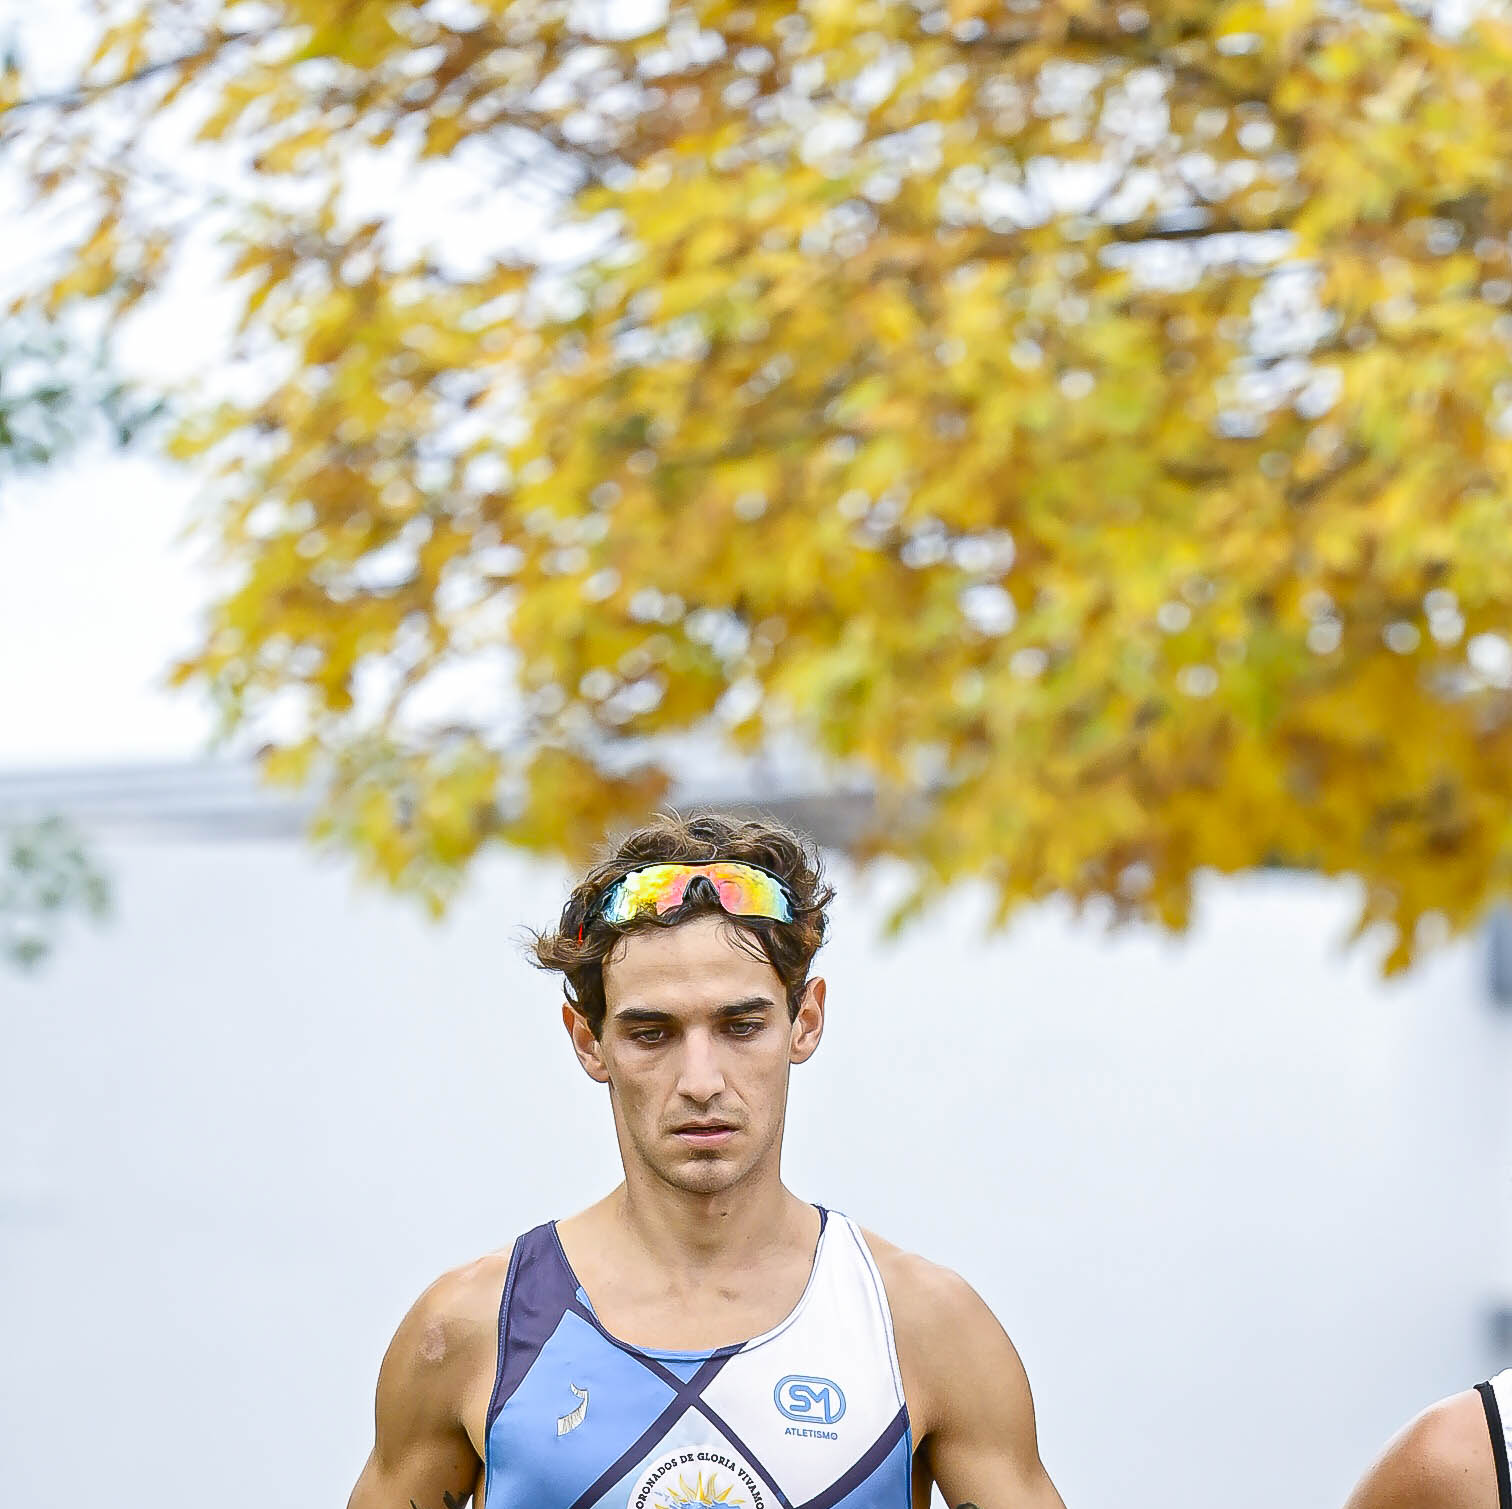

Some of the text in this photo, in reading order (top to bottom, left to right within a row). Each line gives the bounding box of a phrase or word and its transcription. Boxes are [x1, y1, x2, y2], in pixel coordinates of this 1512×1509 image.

[785, 1427, 838, 1441] ATLETISMO
[680, 1453, 695, 1464] DE
[697, 1453, 736, 1472] GLORIA
